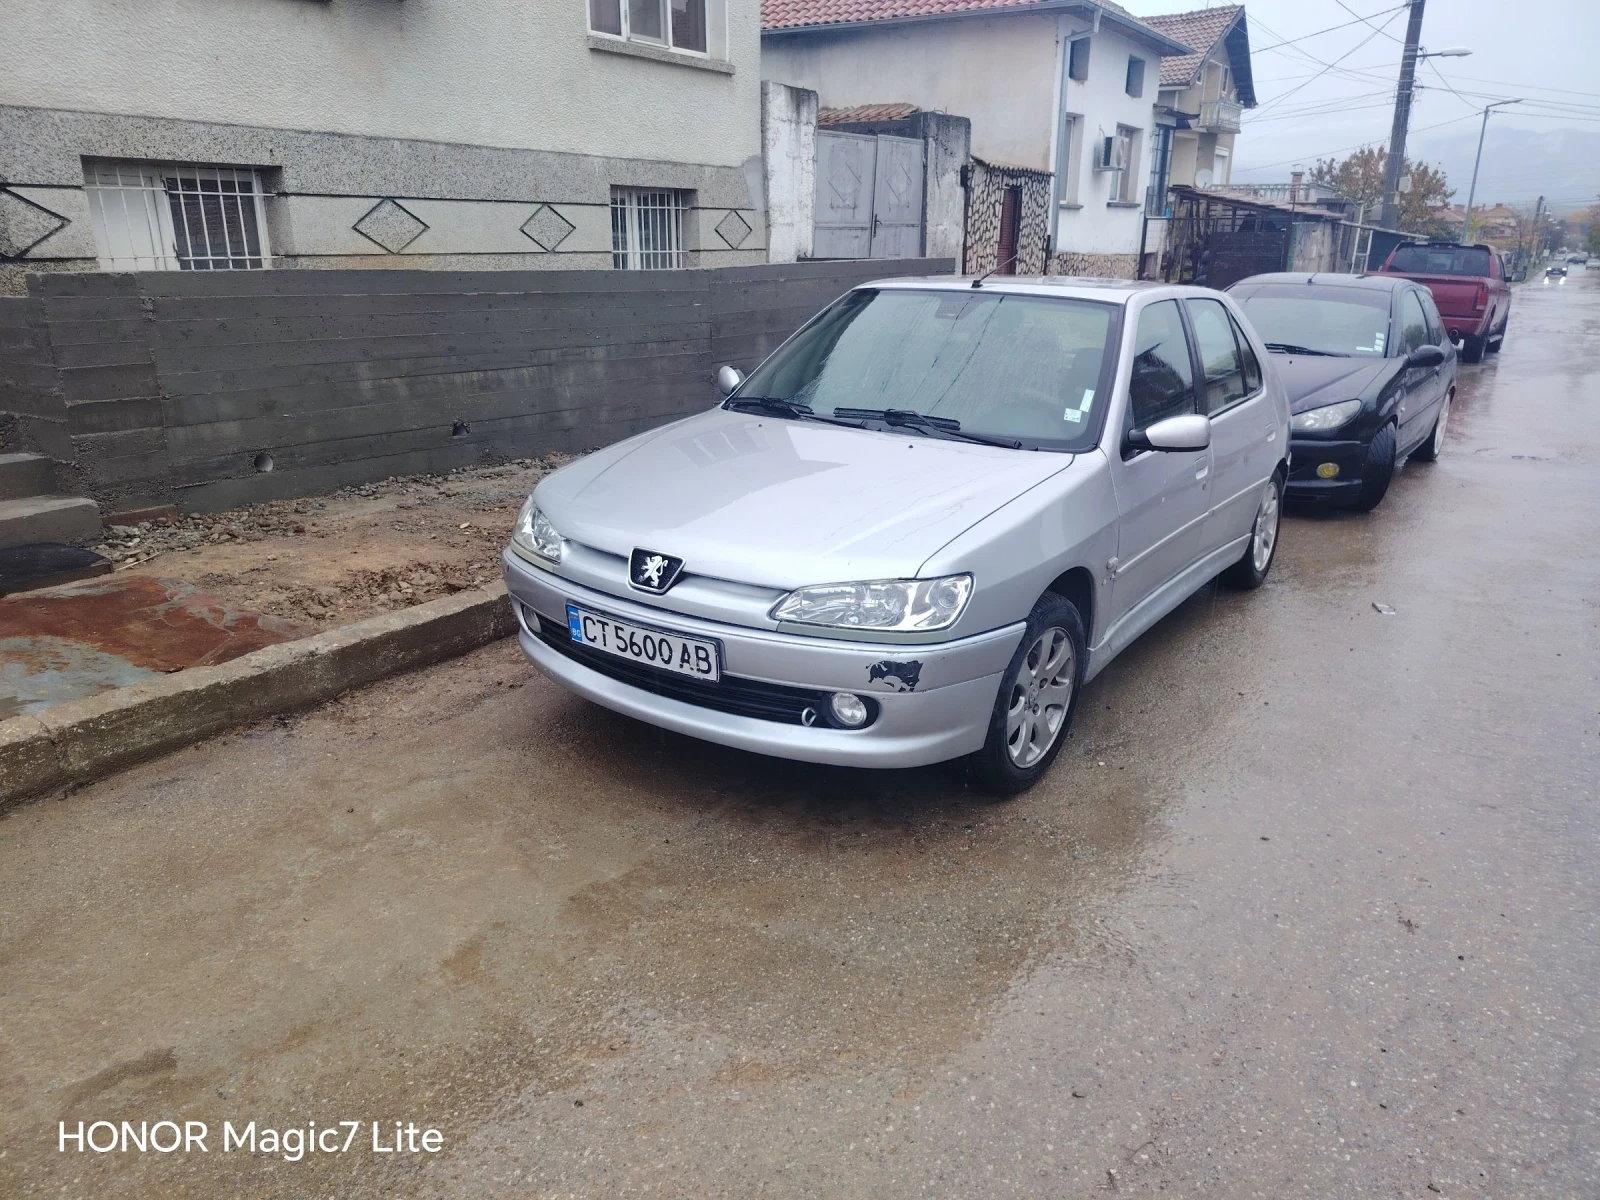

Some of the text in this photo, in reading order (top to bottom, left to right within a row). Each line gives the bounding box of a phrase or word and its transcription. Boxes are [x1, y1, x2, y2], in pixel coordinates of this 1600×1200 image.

[572, 628, 581, 637] BG
[583, 616, 712, 675] CT 5600 AB
